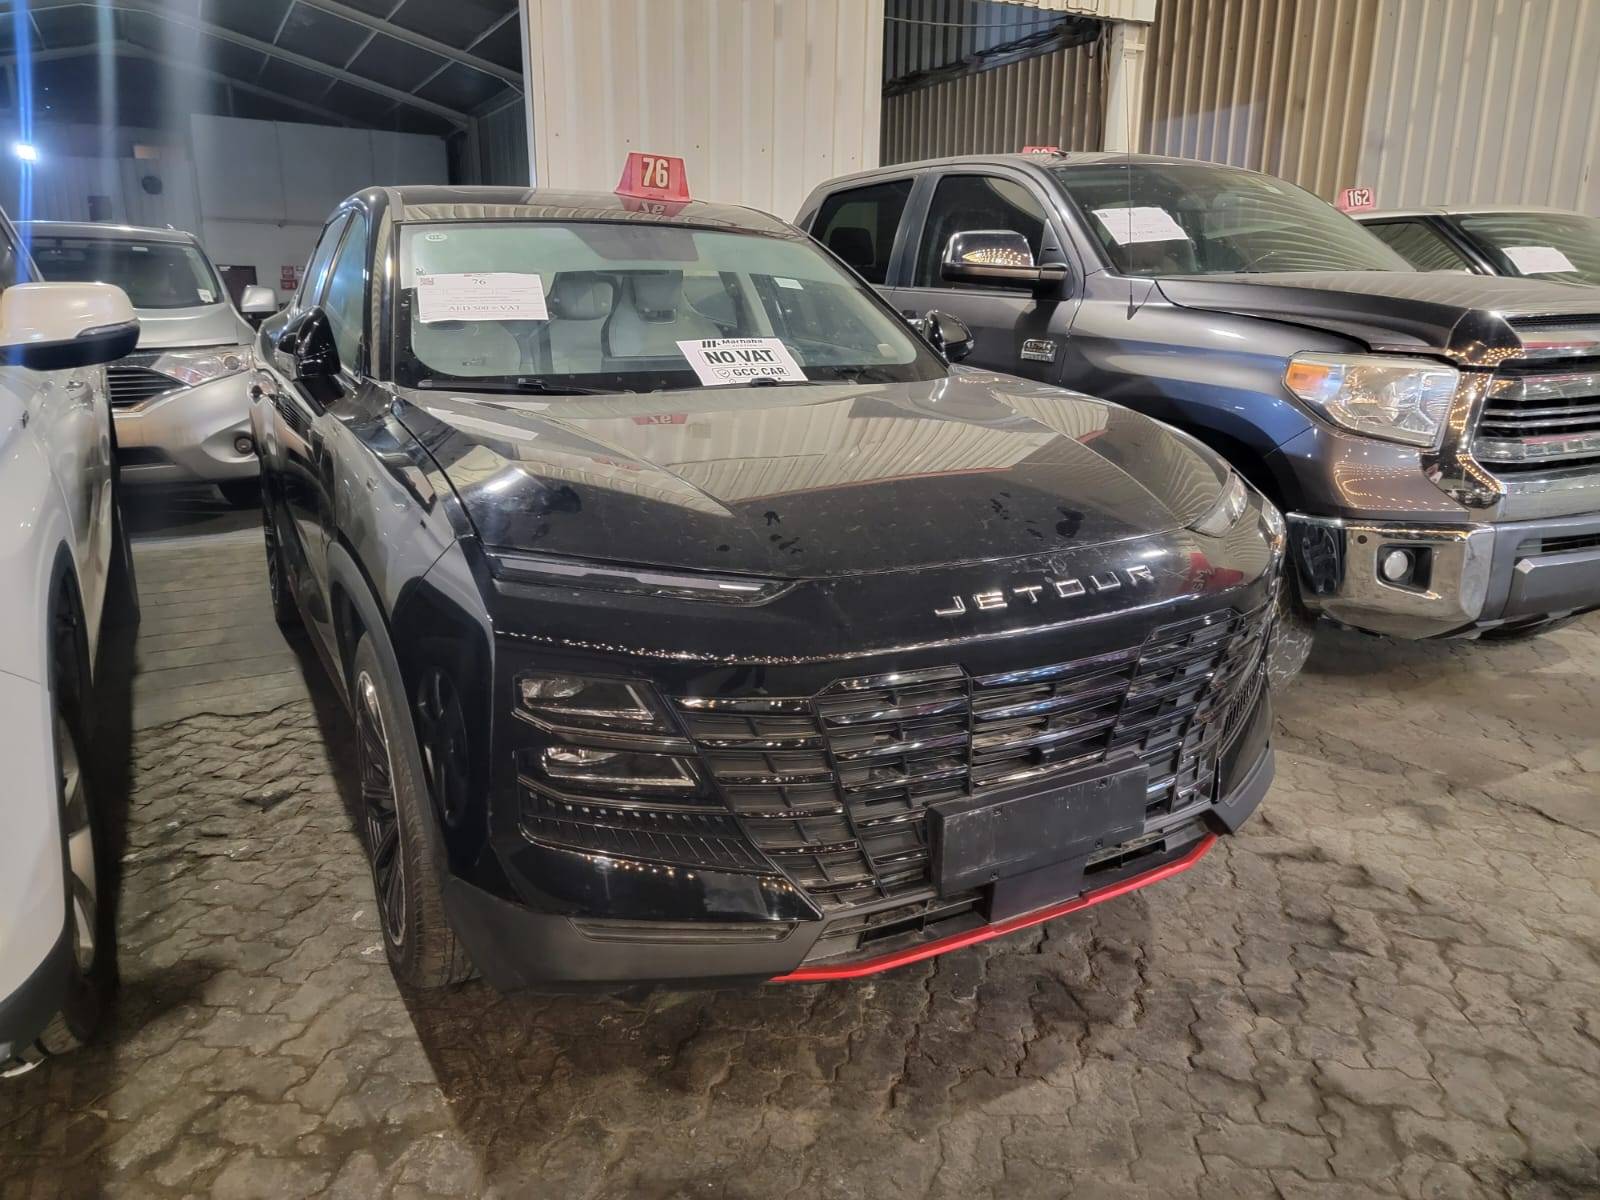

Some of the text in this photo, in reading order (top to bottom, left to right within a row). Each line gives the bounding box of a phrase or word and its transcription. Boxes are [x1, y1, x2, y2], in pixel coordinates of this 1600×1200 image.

[642, 157, 669, 188] 76
[1348, 190, 1371, 207] 162
[704, 349, 775, 364] NO VAT
[732, 367, 788, 377] GCC CAR
[934, 564, 1154, 616] JETOUR
